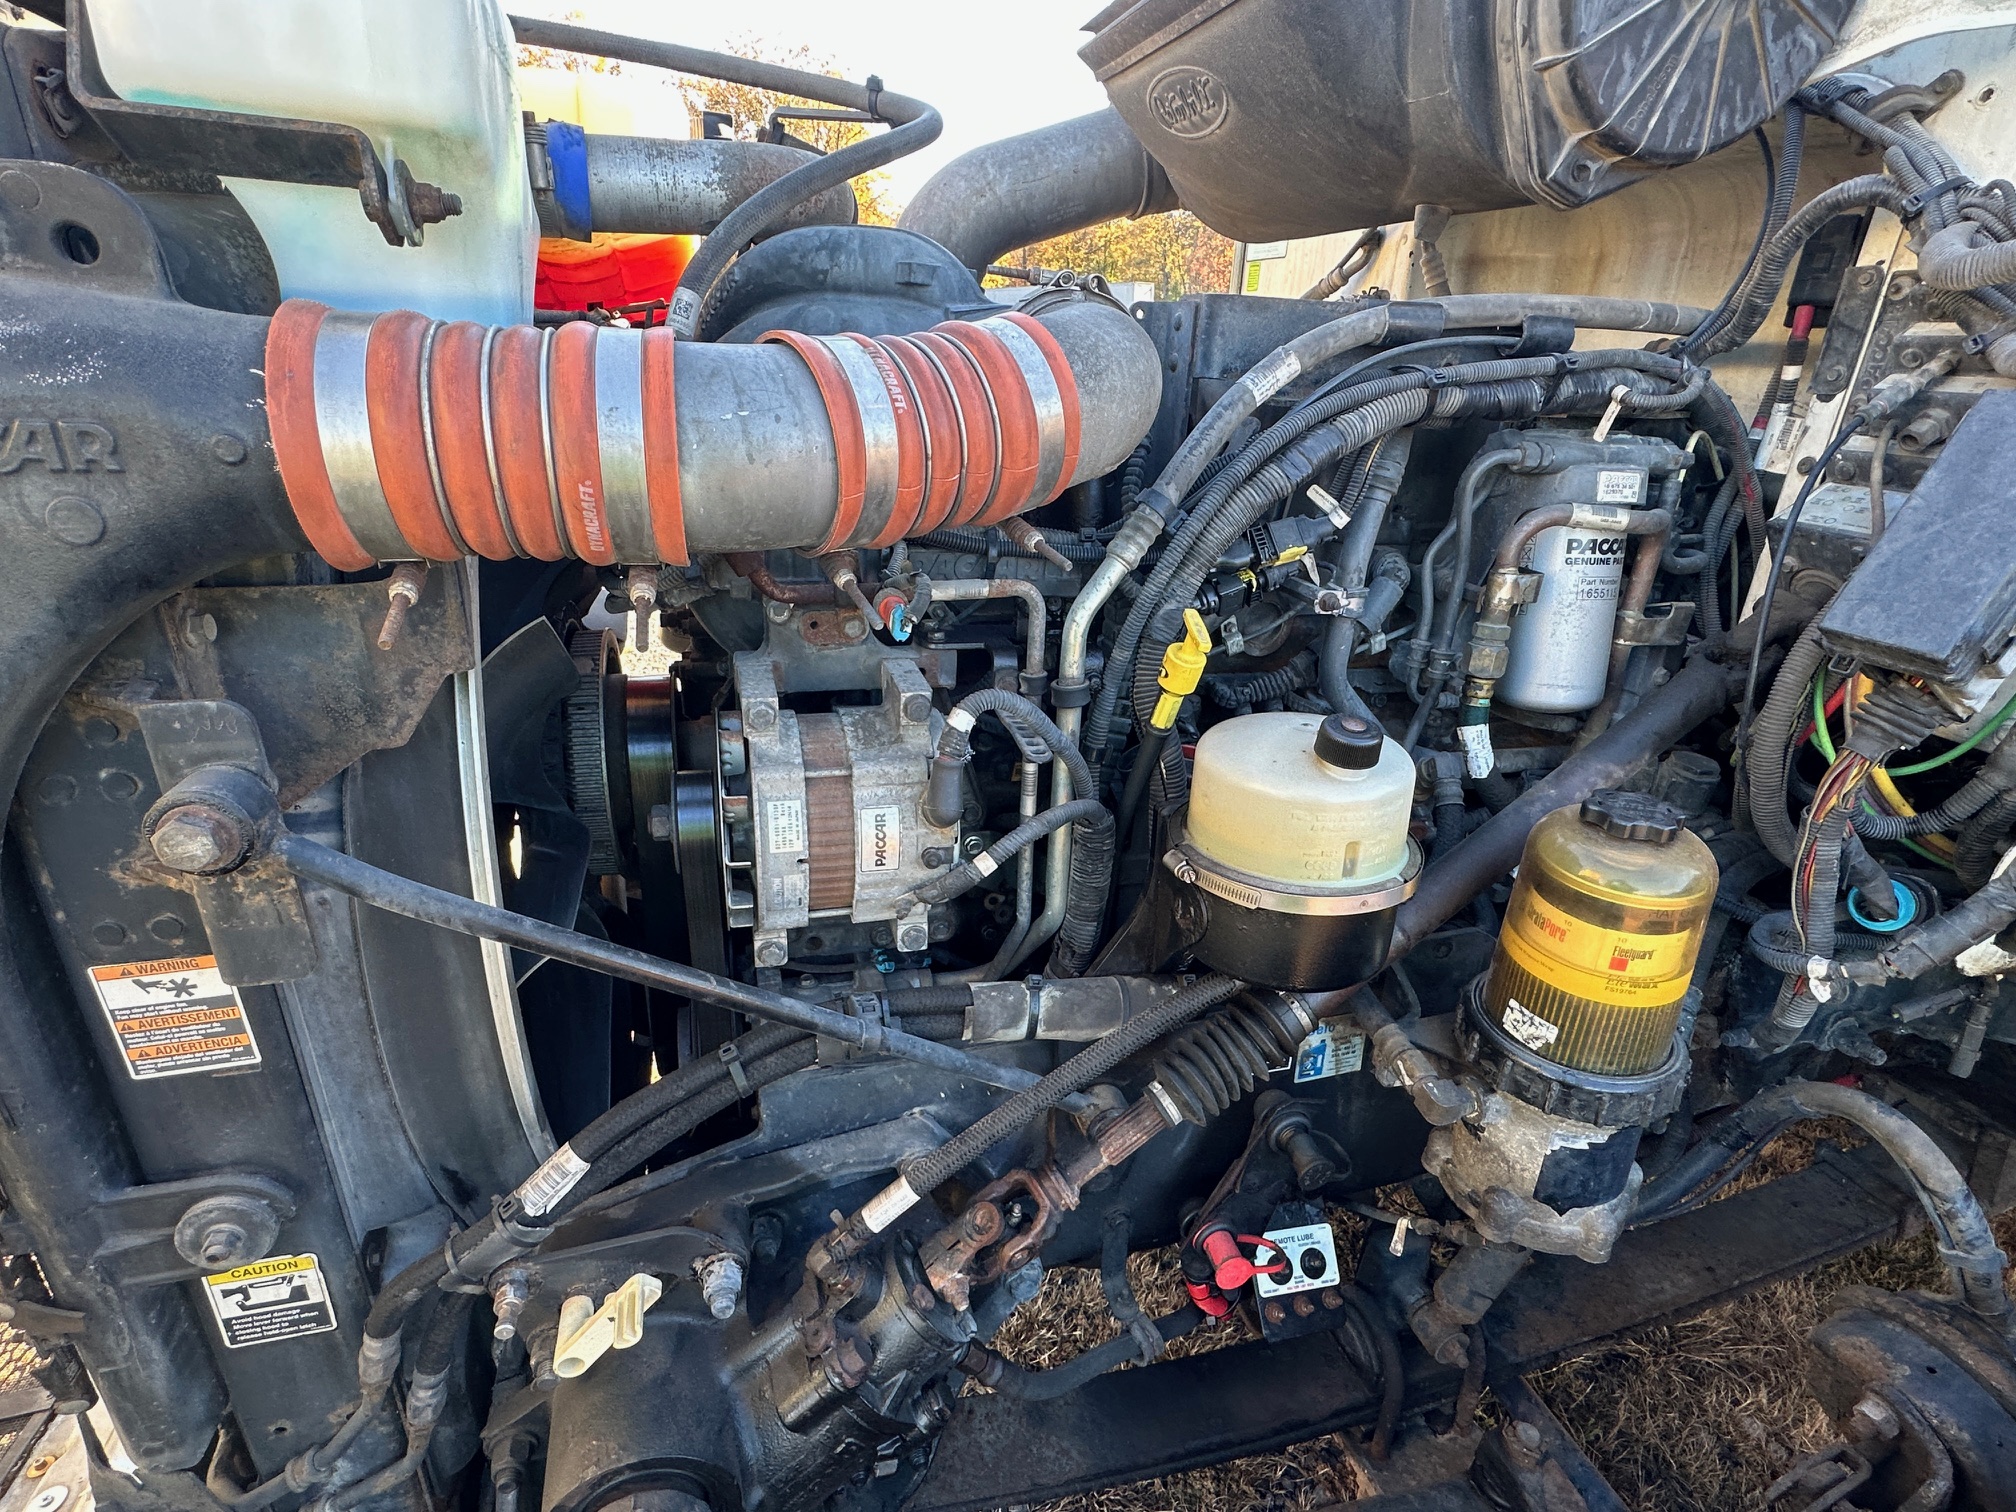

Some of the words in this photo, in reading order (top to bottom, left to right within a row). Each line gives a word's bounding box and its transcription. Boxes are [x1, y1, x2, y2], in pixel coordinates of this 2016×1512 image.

[0, 418, 126, 474] AR
[578, 481, 606, 552] DYNACRAFT
[1566, 538, 1626, 556] PACCA
[1565, 557, 1610, 565] GENUINE
[875, 813, 887, 867] PACCAR
[1612, 945, 1655, 961] Fleetguard
[135, 958, 199, 974] WARNING
[138, 1008, 238, 1029] AVERTISSEMENT
[155, 1036, 242, 1056] ADVERTENCIA
[1297, 1233, 1314, 1242] LUBE
[231, 1261, 298, 1278] CAUTION
[272, 1309, 300, 1317] damage
[234, 1327, 261, 1335] closing
